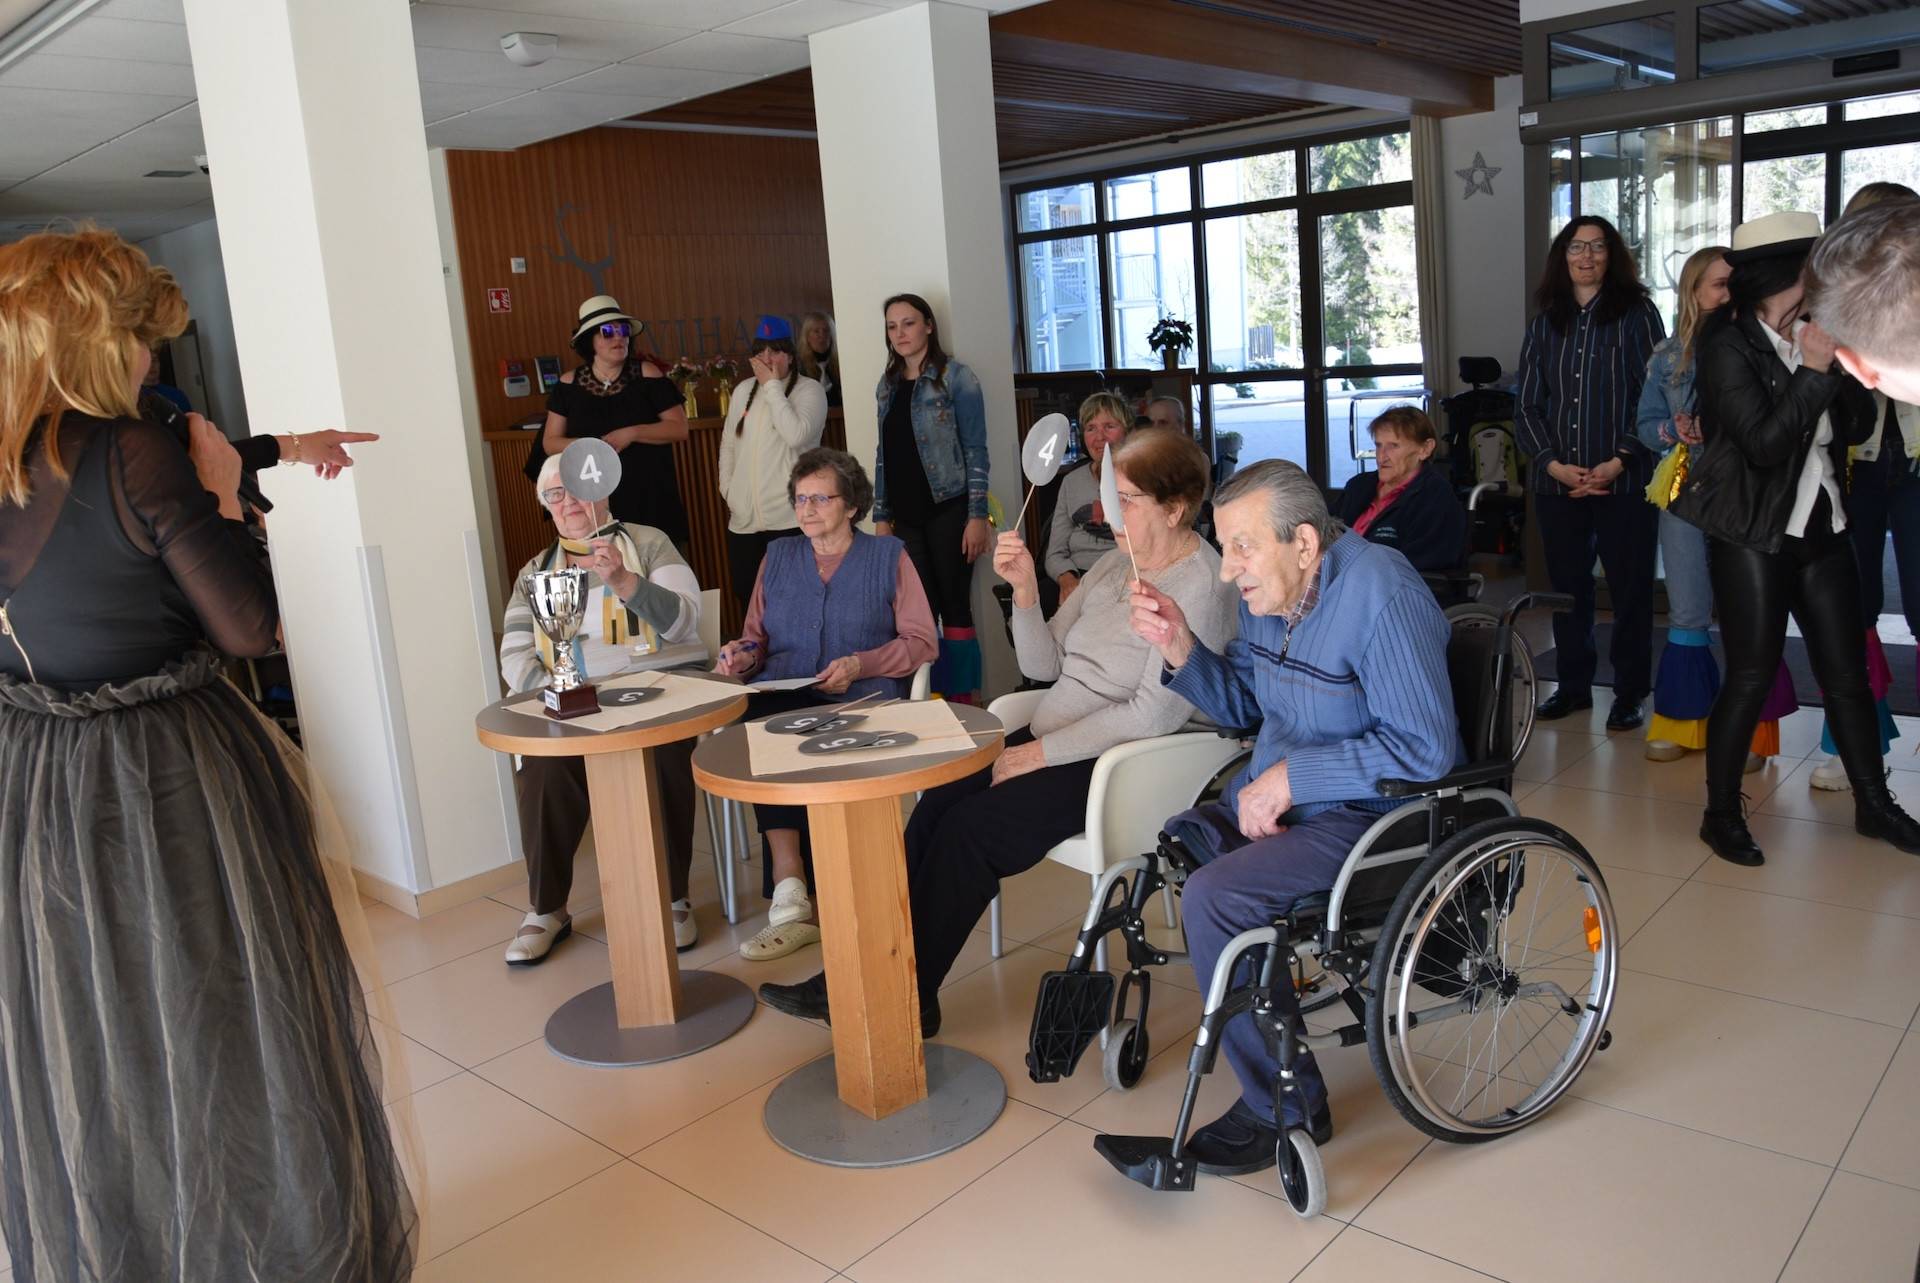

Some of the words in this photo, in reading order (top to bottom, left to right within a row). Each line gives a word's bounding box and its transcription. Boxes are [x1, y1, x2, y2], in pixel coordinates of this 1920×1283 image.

[1038, 433, 1058, 467] 4
[579, 454, 603, 484] 4
[785, 717, 818, 729] 5
[818, 737, 857, 749] 5
